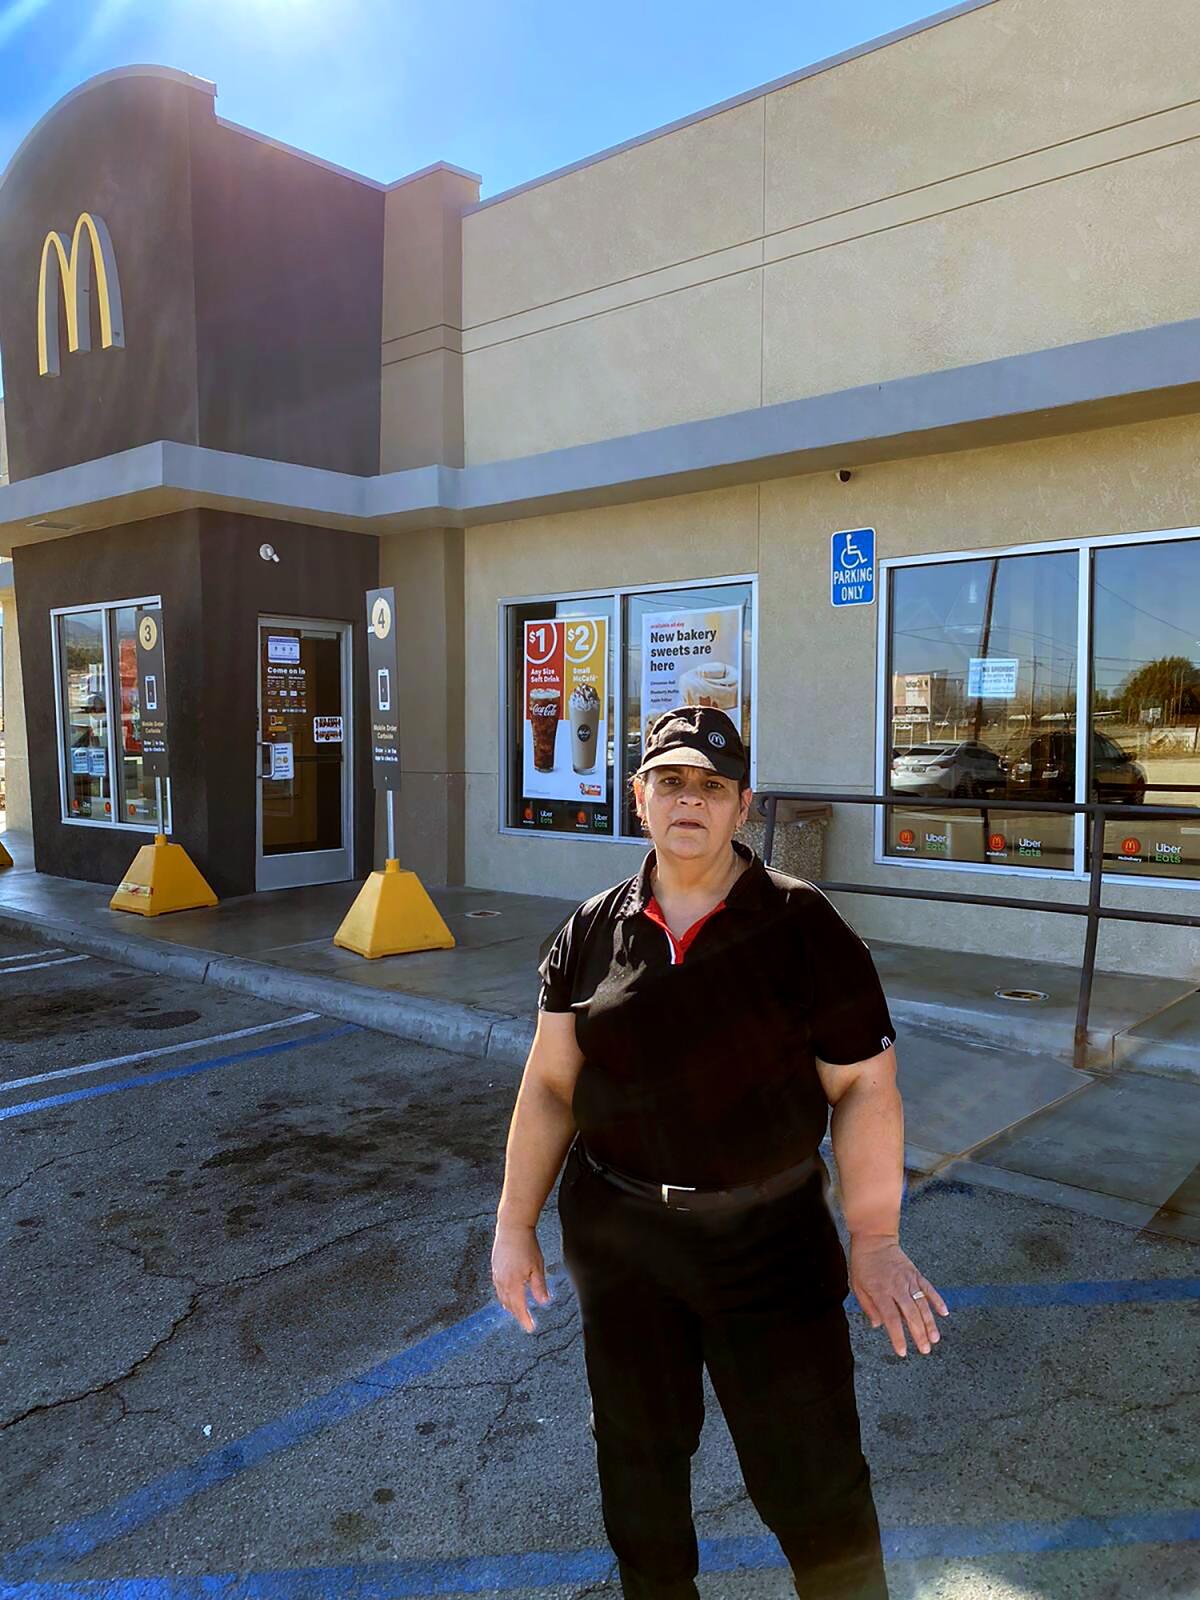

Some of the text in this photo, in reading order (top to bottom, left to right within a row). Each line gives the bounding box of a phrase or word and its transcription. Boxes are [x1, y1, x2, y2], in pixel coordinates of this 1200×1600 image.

[833, 567, 873, 585] PARKING
[841, 585, 864, 601] ONLY
[377, 607, 386, 629] 4
[144, 624, 152, 642] 3
[567, 625, 590, 651] $2
[650, 629, 717, 643] New bakery
[529, 627, 545, 653] $1
[650, 645, 712, 657] sweets are
[267, 666, 288, 674] Come
[531, 667, 555, 676] Any Size
[650, 660, 675, 672] here
[530, 675, 543, 683] Soft
[594, 813, 608, 821] Uber
[925, 833, 946, 842] Uber
[1018, 838, 1041, 848] Uber
[925, 842, 946, 851] Eats
[1019, 847, 1041, 857] Eats
[1155, 842, 1181, 854] Uber
[1155, 853, 1181, 864] Eats
